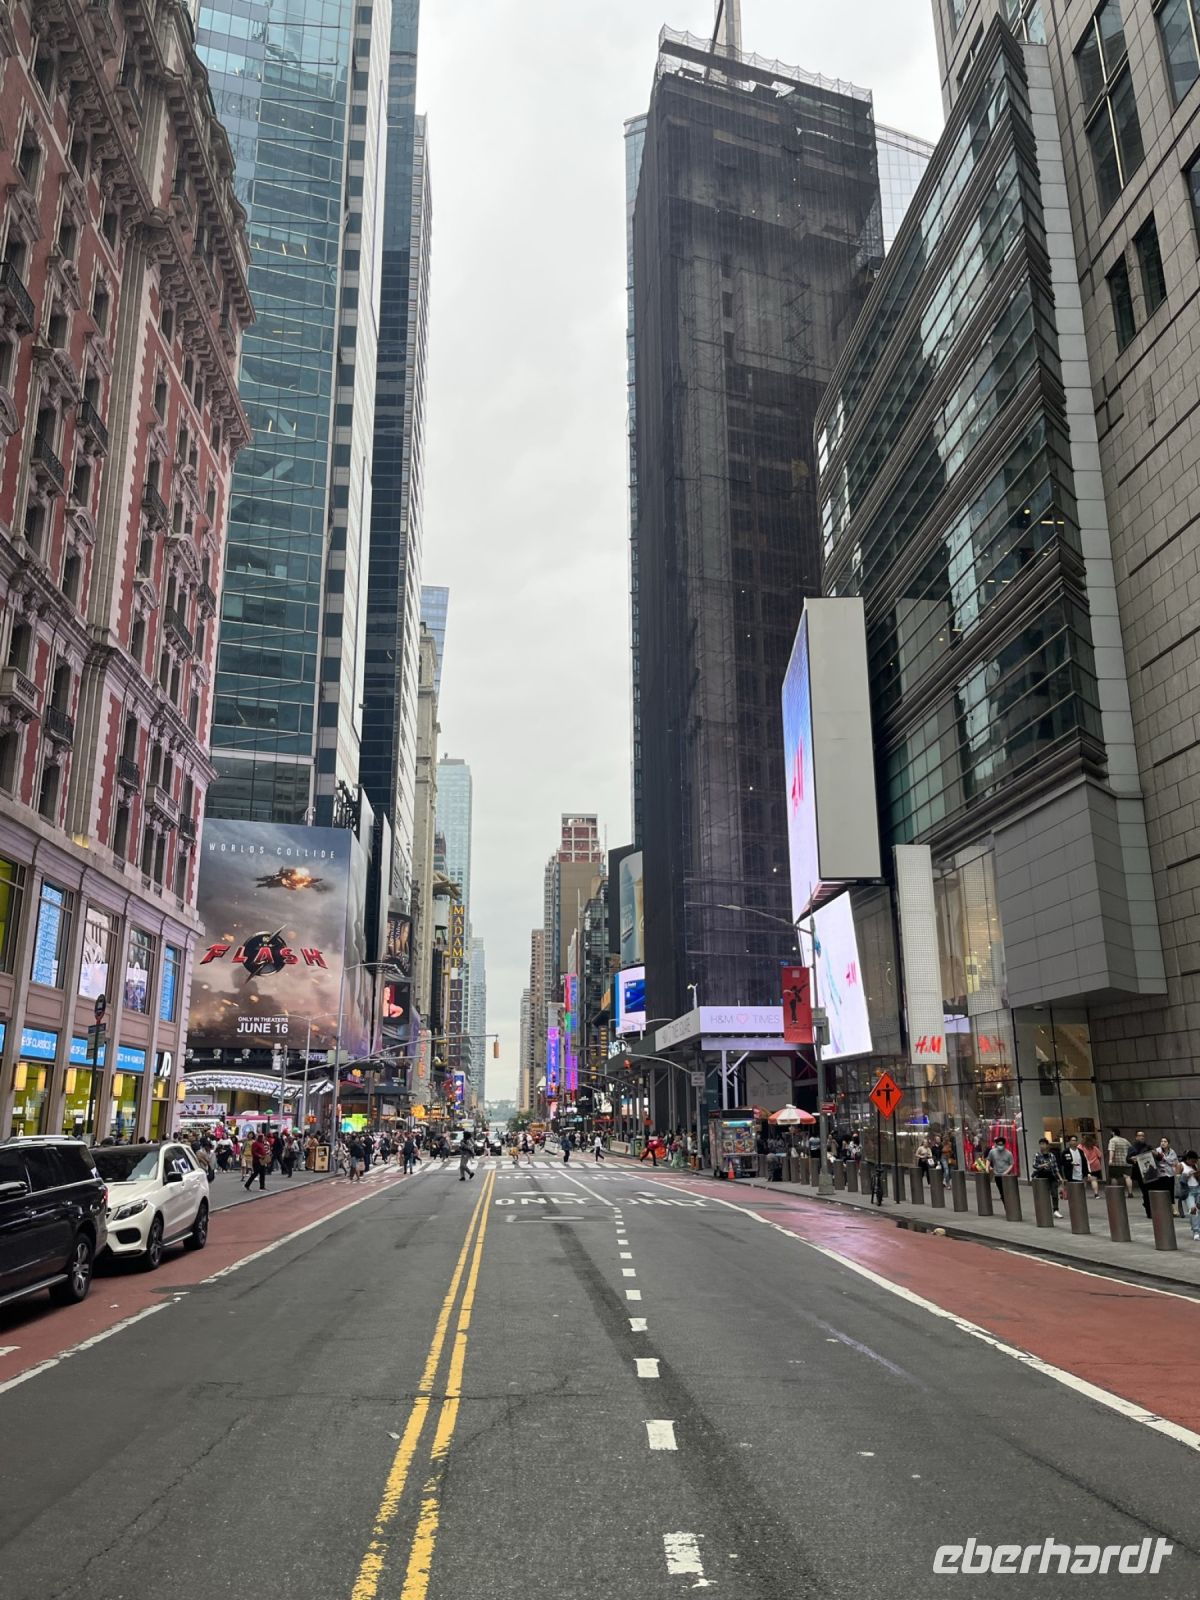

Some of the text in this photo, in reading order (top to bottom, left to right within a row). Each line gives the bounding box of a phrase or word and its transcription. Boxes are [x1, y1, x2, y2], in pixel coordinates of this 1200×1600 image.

[209, 842, 336, 859] WORLDS COLLIDE
[453, 905, 465, 968] MADAME
[200, 943, 329, 970] FLASH
[710, 1014, 781, 1024] H&M TIMES
[237, 1023, 289, 1034] JUNE 16
[914, 1034, 943, 1054] H&M
[494, 1197, 592, 1206] ONLY
[615, 1197, 709, 1207] ONLY
